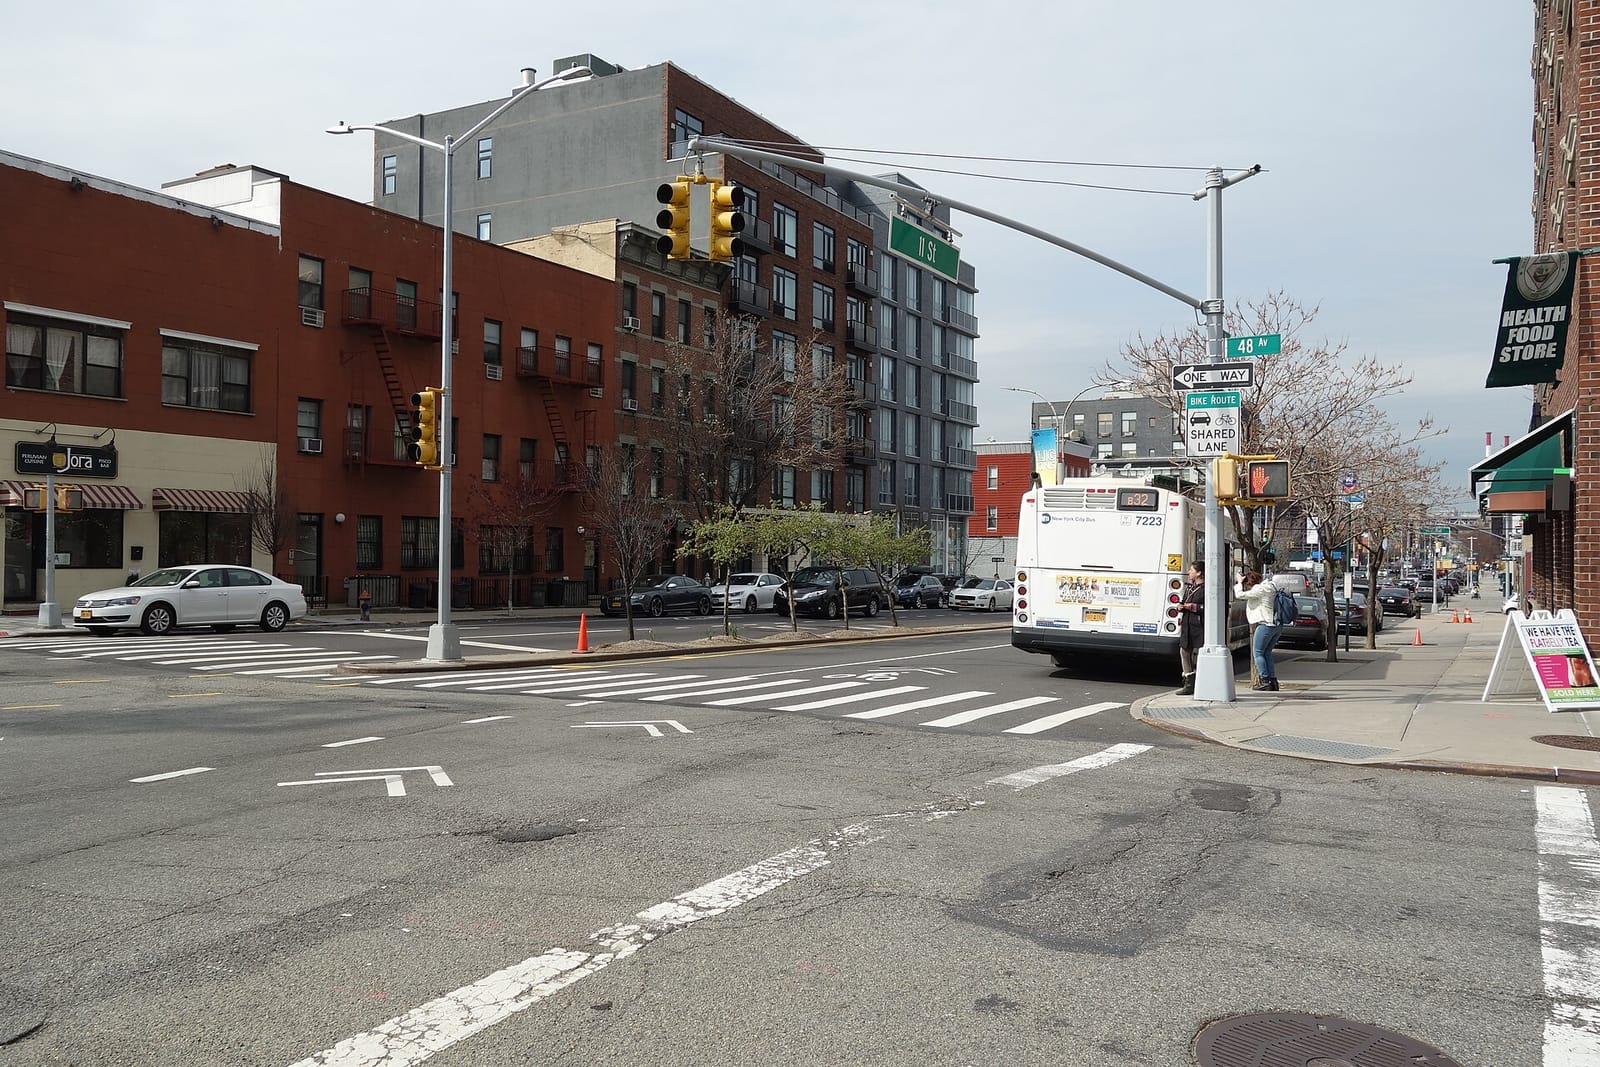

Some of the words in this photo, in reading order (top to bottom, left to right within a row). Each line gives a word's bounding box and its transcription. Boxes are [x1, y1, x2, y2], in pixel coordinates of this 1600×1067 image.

[919, 236, 925, 257] 11
[927, 241, 936, 263] St
[1502, 306, 1566, 327] HEALTH
[1507, 325, 1554, 344] FOOD
[1238, 338, 1253, 354] 48
[1258, 337, 1268, 347] Av
[1499, 342, 1556, 363] STORE
[1183, 372, 1207, 382] ONE
[1220, 370, 1246, 380] WAY
[1190, 397, 1208, 405] BIKE
[1210, 395, 1236, 404] ROUTE
[1190, 429, 1235, 439] SHARED
[1197, 441, 1228, 451] LANE
[1135, 516, 1162, 526] 7223
[1526, 627, 1538, 637] WE
[1540, 627, 1561, 636] HAVE
[1561, 626, 1576, 635] THE
[1565, 638, 1579, 646] TEA
